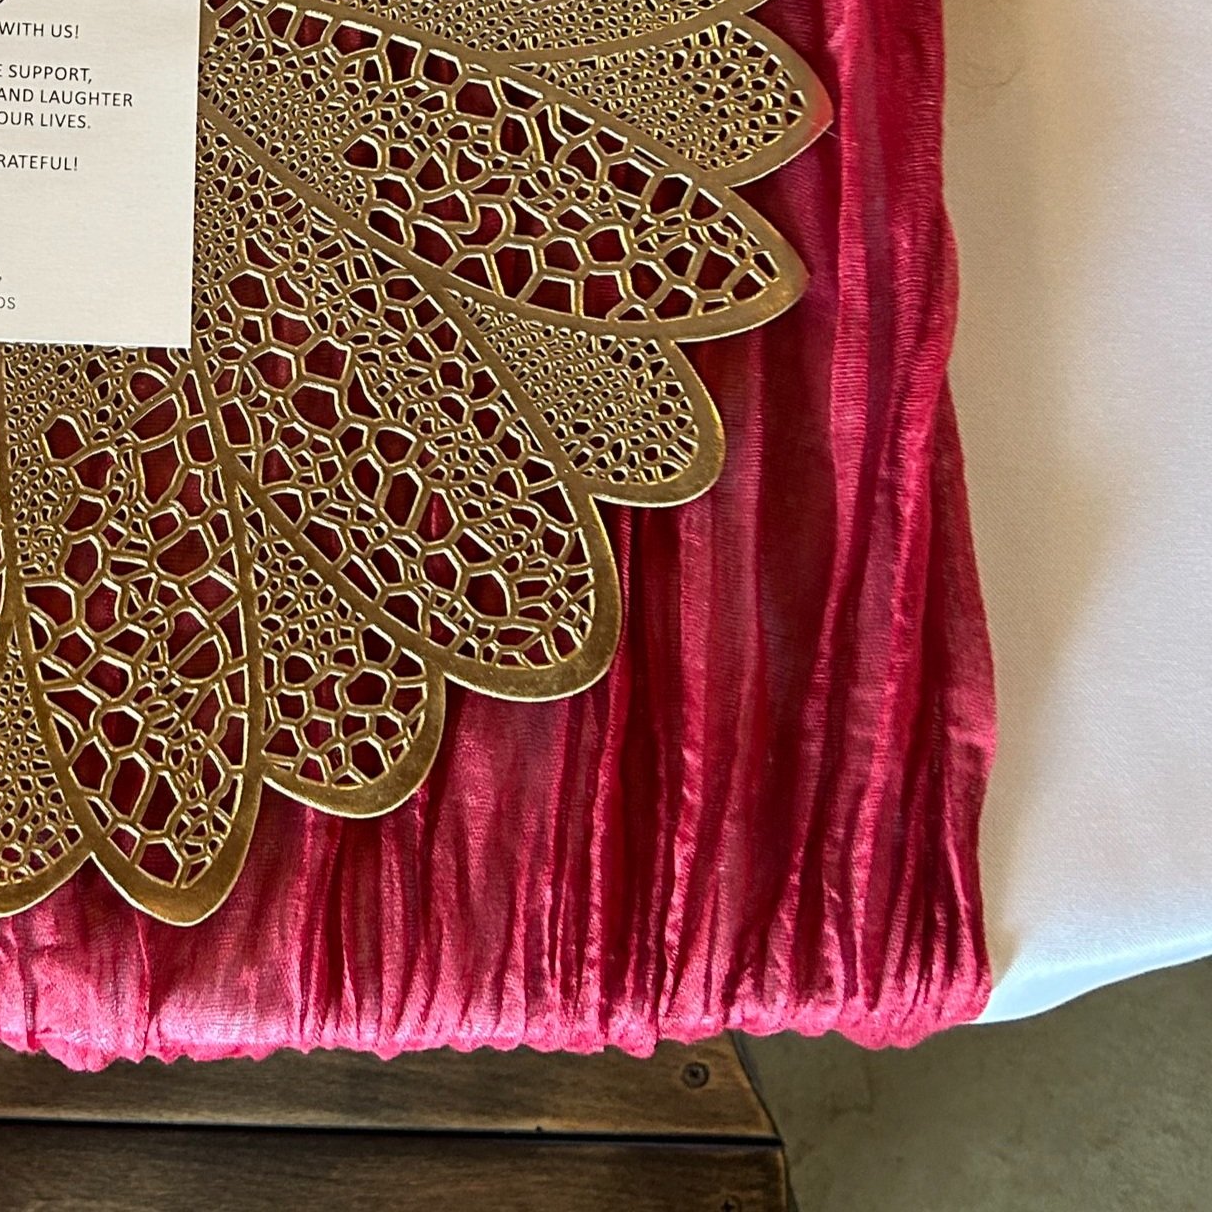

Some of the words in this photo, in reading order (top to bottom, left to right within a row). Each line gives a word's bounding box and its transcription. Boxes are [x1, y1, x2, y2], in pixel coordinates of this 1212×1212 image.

[50, 23, 79, 40] US!
[8, 64, 92, 85] SUPPORT,
[40, 89, 133, 108] LAUGHTER
[40, 112, 91, 129] LIVES.
